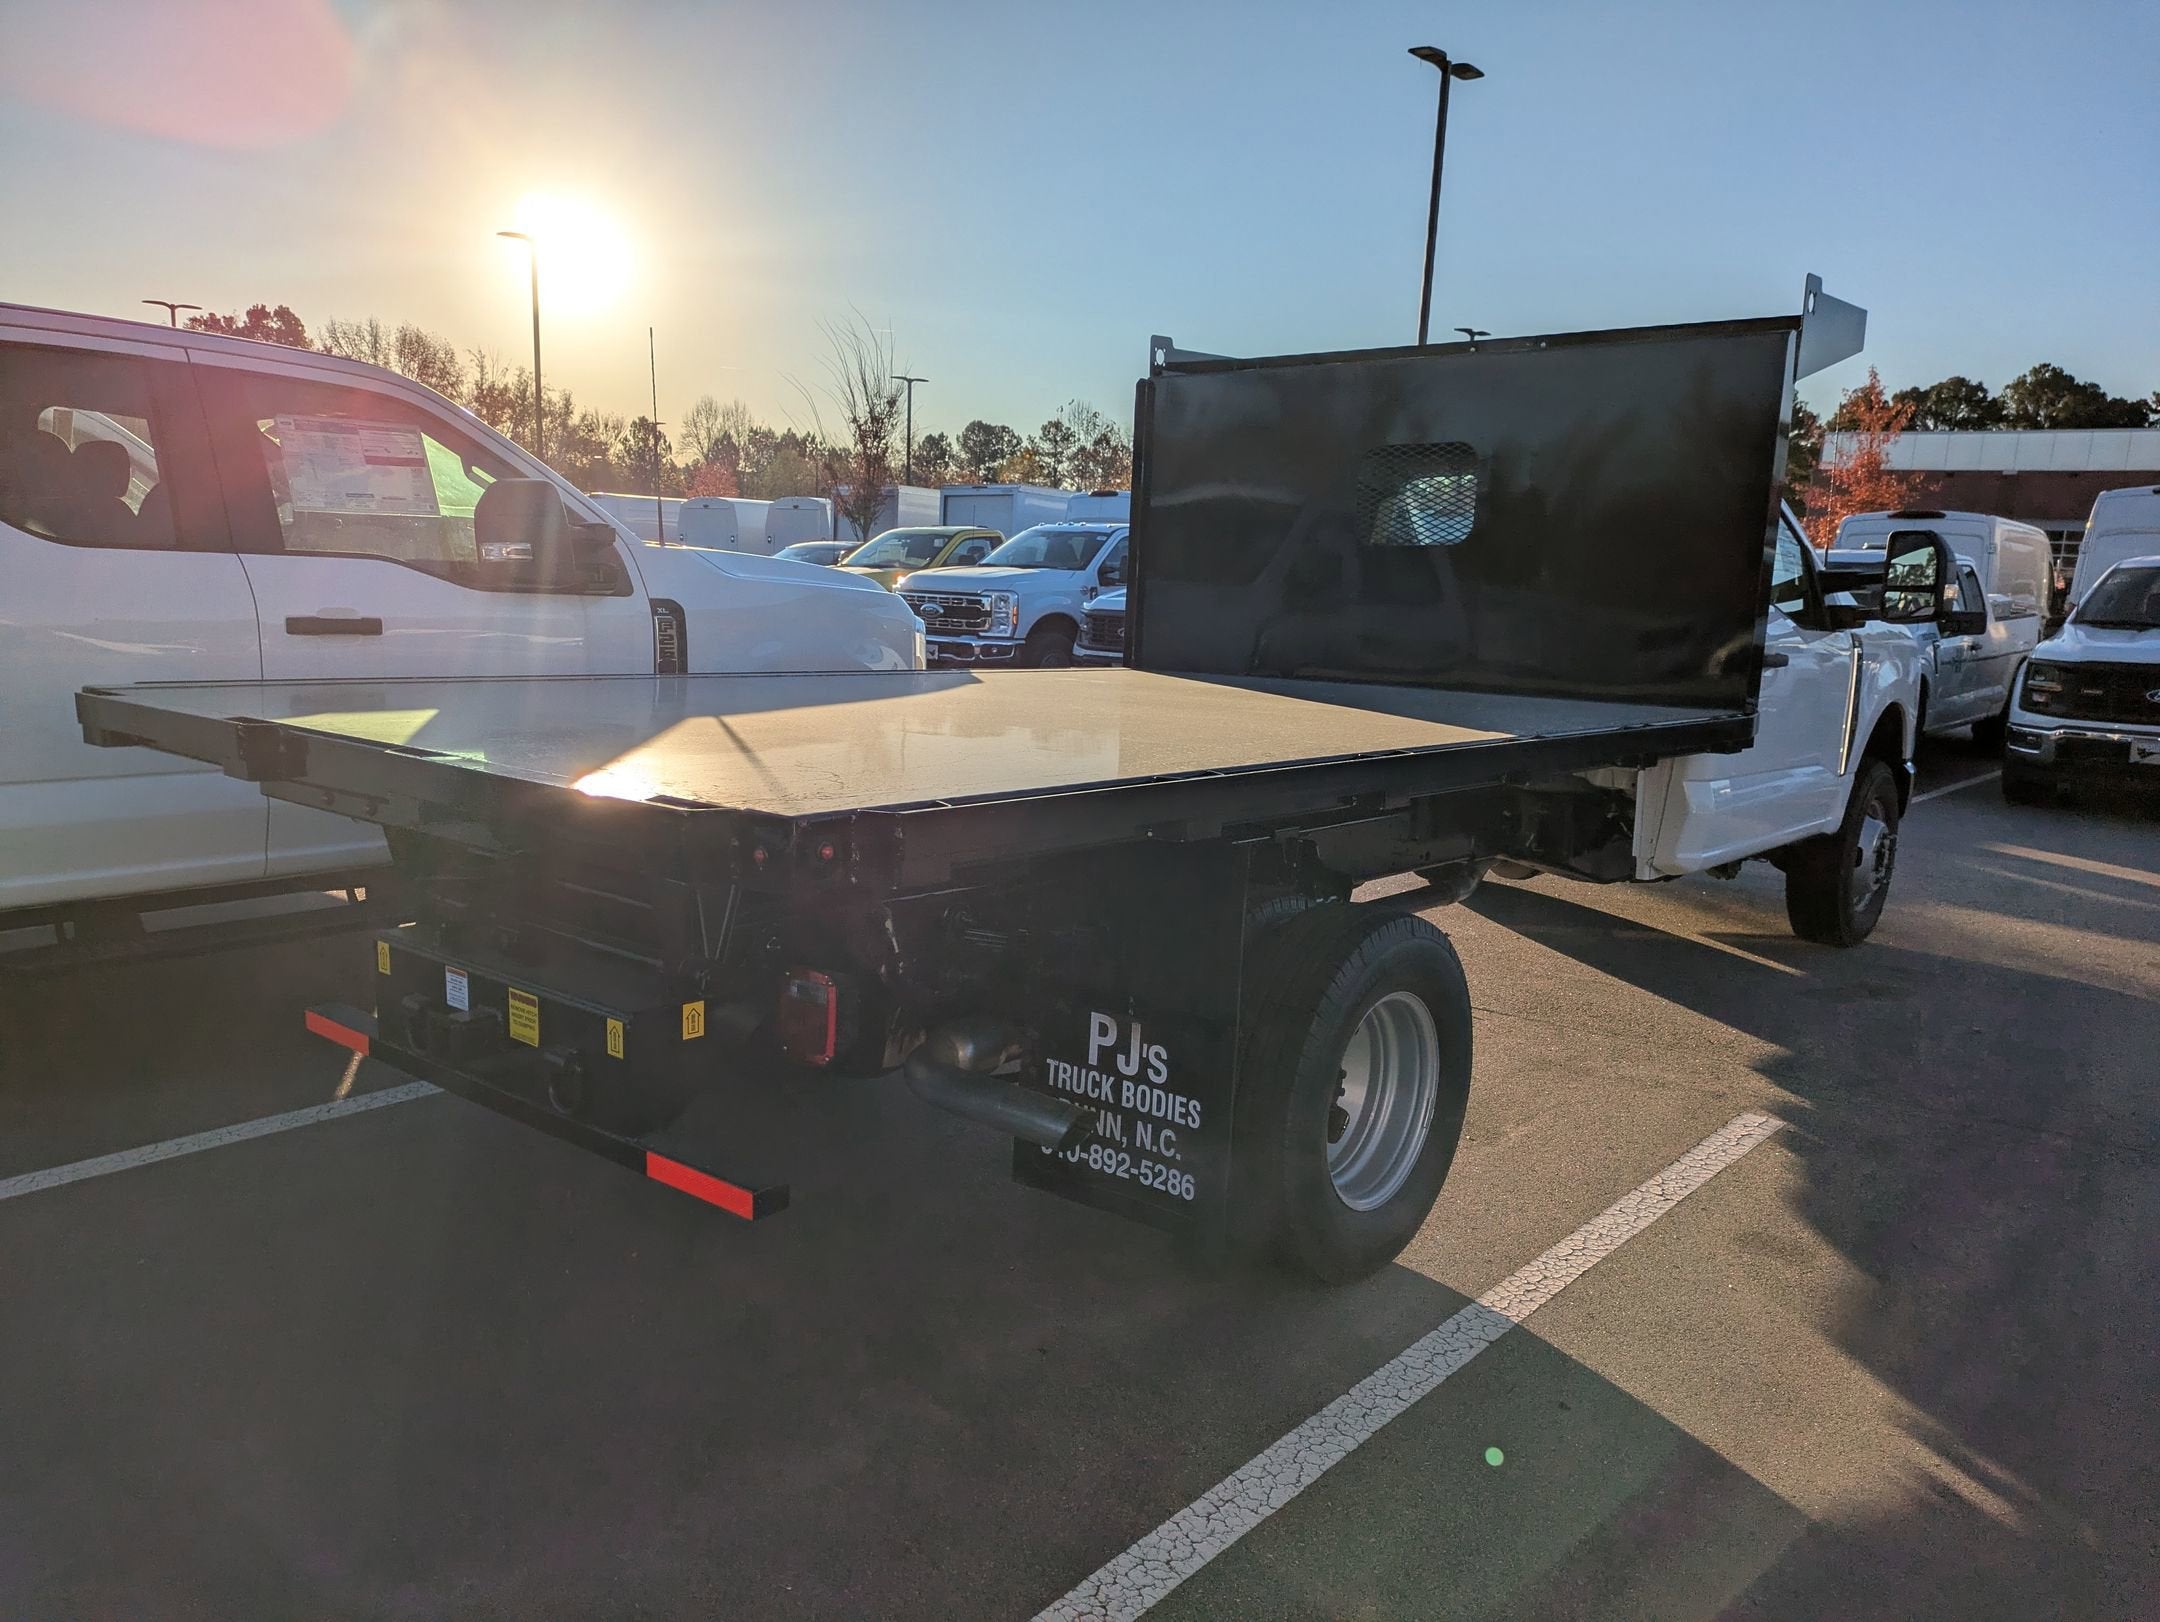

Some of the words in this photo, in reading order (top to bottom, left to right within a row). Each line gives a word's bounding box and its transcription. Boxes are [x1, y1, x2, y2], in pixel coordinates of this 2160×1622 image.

[1087, 1011, 1168, 1085] PJ'S
[1046, 1058, 1115, 1104] TRUCK
[1121, 1079, 1201, 1129] BODIES
[1041, 1143, 1195, 1201] 0-892-5286
[1135, 1120, 1182, 1161] N.C.
